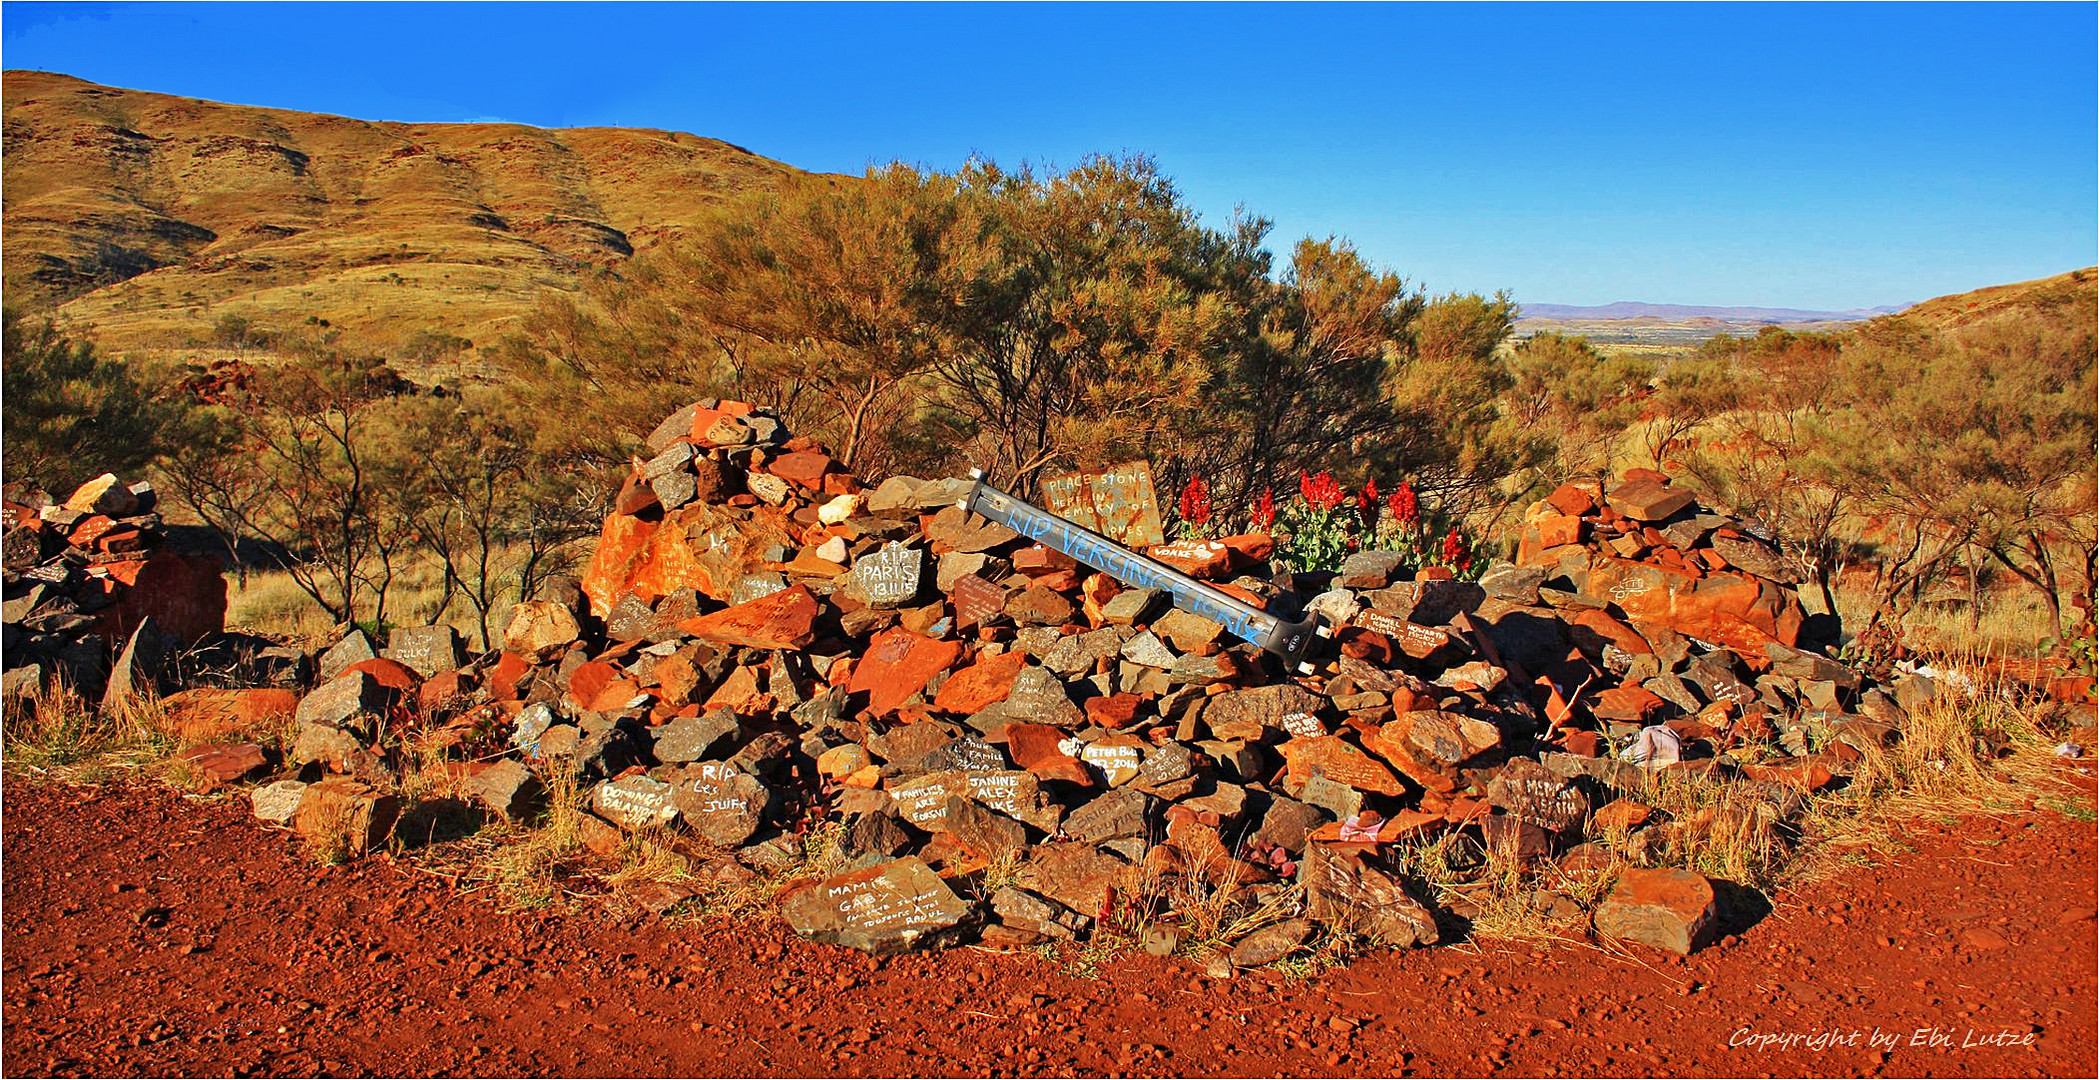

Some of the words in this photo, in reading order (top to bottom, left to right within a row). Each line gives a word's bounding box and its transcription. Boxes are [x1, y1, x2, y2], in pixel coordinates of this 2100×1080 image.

[1049, 474, 1092, 492] PLACE
[1101, 471, 1147, 486] STONE
[1131, 500, 1149, 511] OF
[1006, 508, 1054, 541] RIP
[863, 565, 915, 582] PARIS
[1086, 746, 1118, 758] PETER
[702, 763, 738, 782] RIP
[969, 775, 1019, 787] JANINE
[976, 787, 1017, 799] ALEX
[915, 798, 937, 810] ARE
